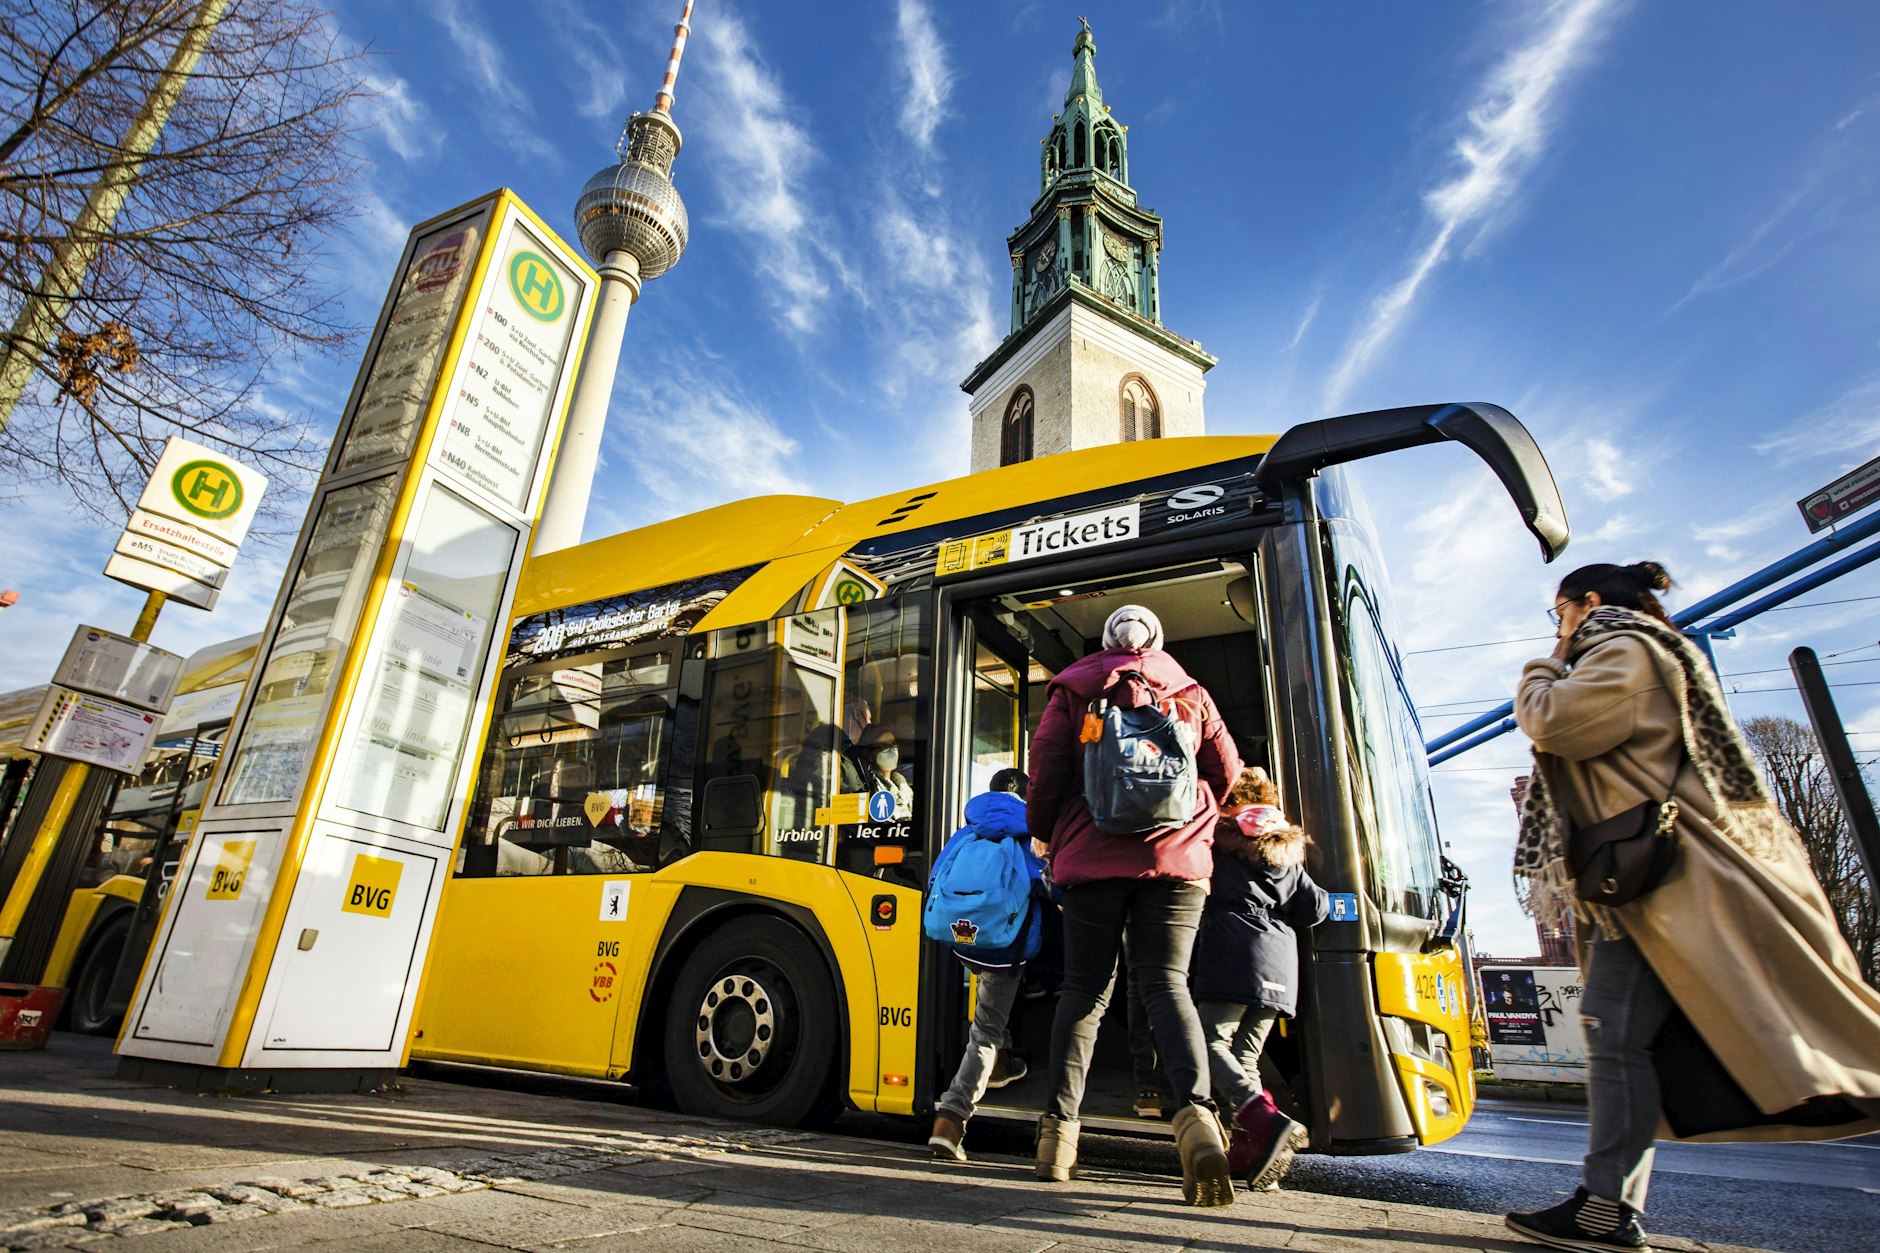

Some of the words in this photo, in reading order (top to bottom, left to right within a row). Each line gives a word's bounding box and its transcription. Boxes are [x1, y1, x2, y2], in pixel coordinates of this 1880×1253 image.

[494, 311, 508, 327] 100
[483, 337, 500, 355] 200
[509, 332, 518, 343] via
[518, 339, 545, 366] Reichstag
[538, 348, 557, 366] Garten
[475, 365, 489, 380] N2
[506, 362, 536, 389] Potsdamer
[530, 373, 549, 391] Garten
[494, 378, 512, 395] U-Bhf
[466, 393, 480, 407] N5
[492, 385, 520, 409] Ruhleben
[457, 422, 471, 437] N8
[483, 413, 526, 446] Hauptbahnhof
[474, 443, 520, 477] Hermannstraße
[447, 452, 466, 470] N40
[467, 464, 499, 489] Karlshorst
[1167, 506, 1225, 524] SOLARIS
[142, 519, 225, 557] Ersatzhaltestelle
[1019, 514, 1131, 556] Tickets
[532, 623, 566, 655] 200
[566, 618, 586, 637] S+U
[586, 608, 646, 633] Zoologischer
[572, 637, 586, 647] via
[588, 627, 638, 644] Potsdamer
[641, 620, 669, 633] Platz
[391, 639, 442, 667] Naclinie
[370, 718, 426, 744] Naclinie
[591, 802, 605, 812] BVG
[521, 820, 535, 829] WIR
[536, 818, 554, 829] DICH
[556, 816, 584, 827] LIEBEN.
[774, 828, 823, 843] Urbino
[211, 870, 243, 892] BVG
[350, 884, 391, 910] BVG
[597, 941, 620, 957] BVG
[593, 975, 613, 988] VBB
[880, 1006, 912, 1027] BVG
[1521, 1012, 1539, 1020] DYK
